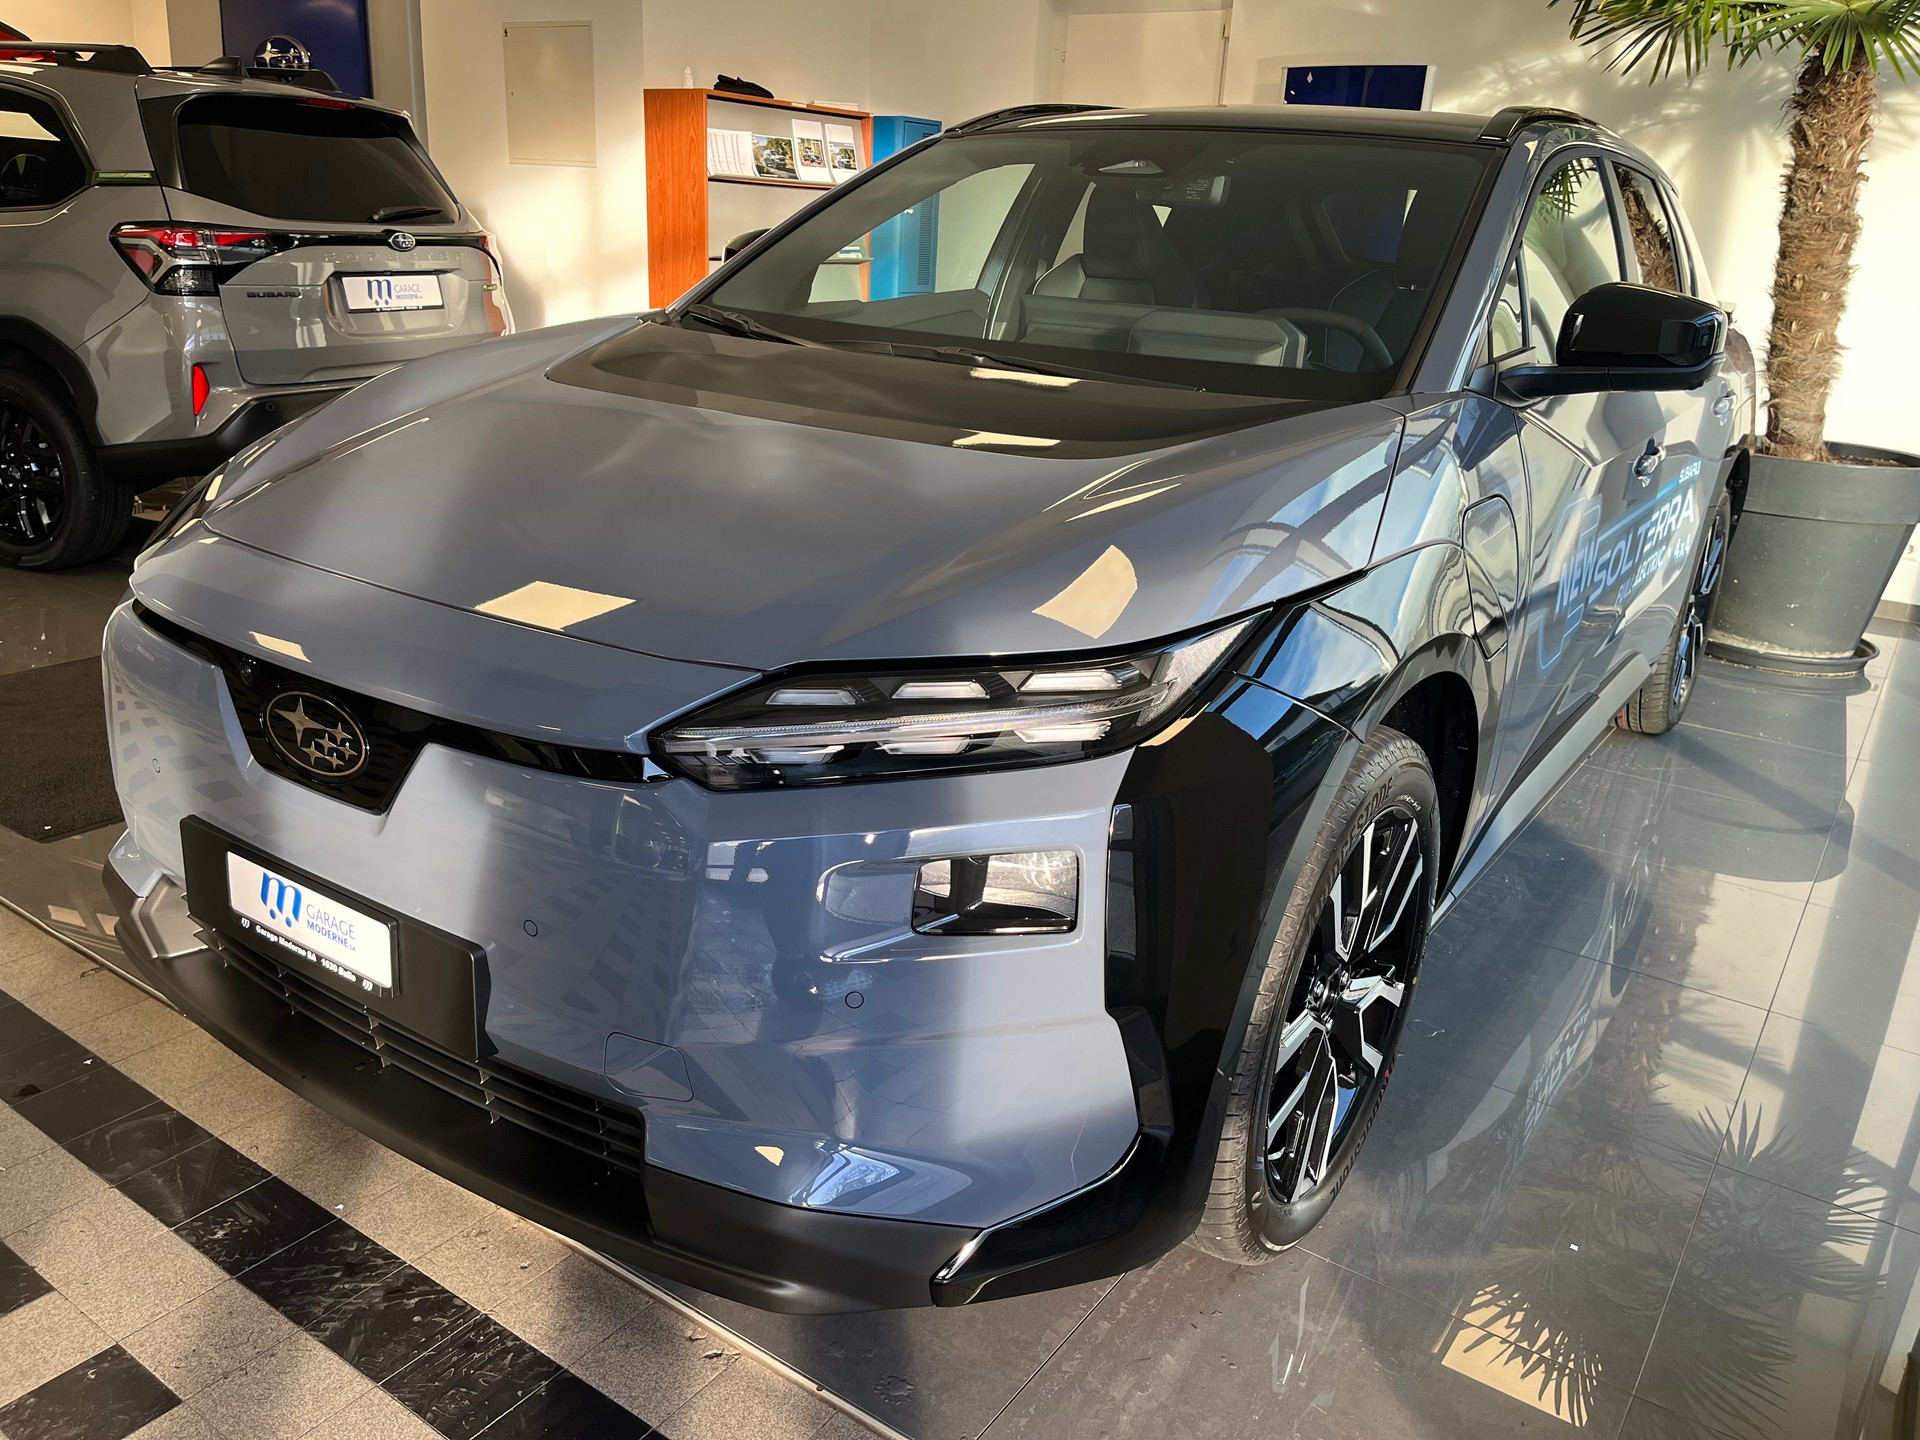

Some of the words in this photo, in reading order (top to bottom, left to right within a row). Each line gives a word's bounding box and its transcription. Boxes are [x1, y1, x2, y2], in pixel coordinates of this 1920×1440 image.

[393, 284, 422, 294] GARAGE
[1678, 459, 1701, 484] SUBARU
[1555, 539, 1600, 613] NEW
[1588, 488, 1695, 604] SOLTERRA
[1632, 545, 1666, 588] ELECTRIC
[1673, 533, 1692, 559] 4x4
[306, 903, 356, 941] GARAGE
[306, 919, 349, 949] MODERNE
[255, 924, 279, 942] Garage
[278, 936, 307, 957] Moderne
[306, 950, 317, 963] SA
[320, 957, 338, 973] 1630
[338, 966, 357, 982] Bulle
